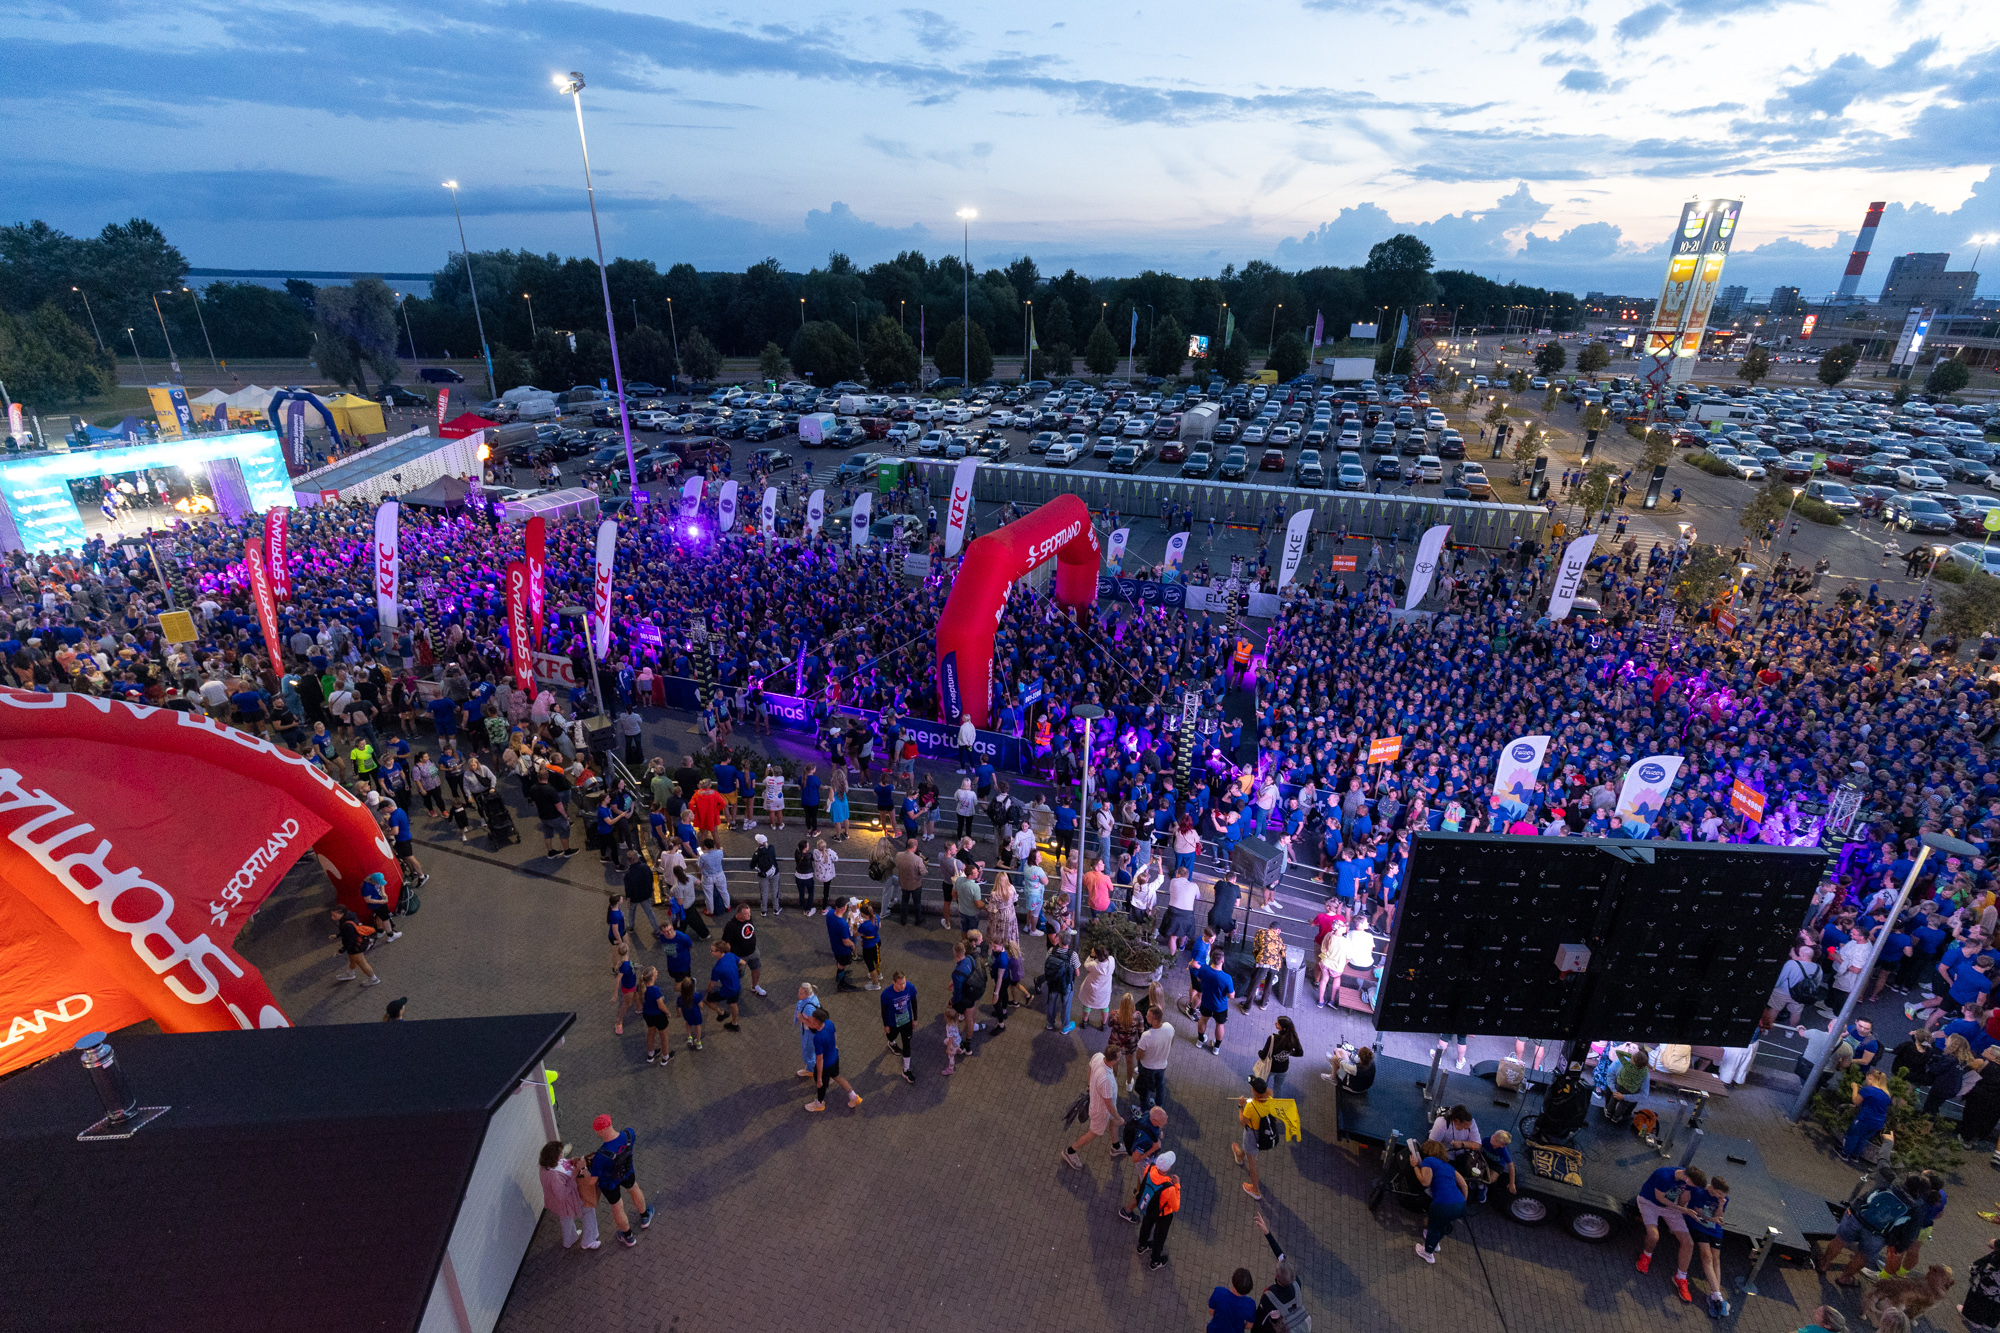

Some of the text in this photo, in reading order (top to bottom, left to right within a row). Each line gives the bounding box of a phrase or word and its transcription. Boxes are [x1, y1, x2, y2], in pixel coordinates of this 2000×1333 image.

[1680, 240, 1700, 252] 10-21
[950, 487, 968, 530] KFC
[1987, 516, 1998, 525] 2
[271, 512, 286, 581] SPORTLAND
[1039, 520, 1081, 560] SPORTLAND
[1286, 534, 1303, 569] ELKE
[379, 543, 394, 600] KFC
[530, 557, 542, 614] KFC
[1559, 561, 1582, 599] ELKE
[250, 548, 276, 639] SPORTLAND
[595, 562, 611, 625] KFC
[1142, 587, 1157, 597] Fazer
[1164, 589, 1180, 599] Fazer
[512, 570, 531, 662] SPORTLAND
[531, 656, 576, 685] KFC
[947, 663, 957, 704] neptūnas
[1513, 746, 1535, 758] Fazer
[1640, 766, 1665, 778] Fazer
[221, 817, 300, 911] SPORTLAND
